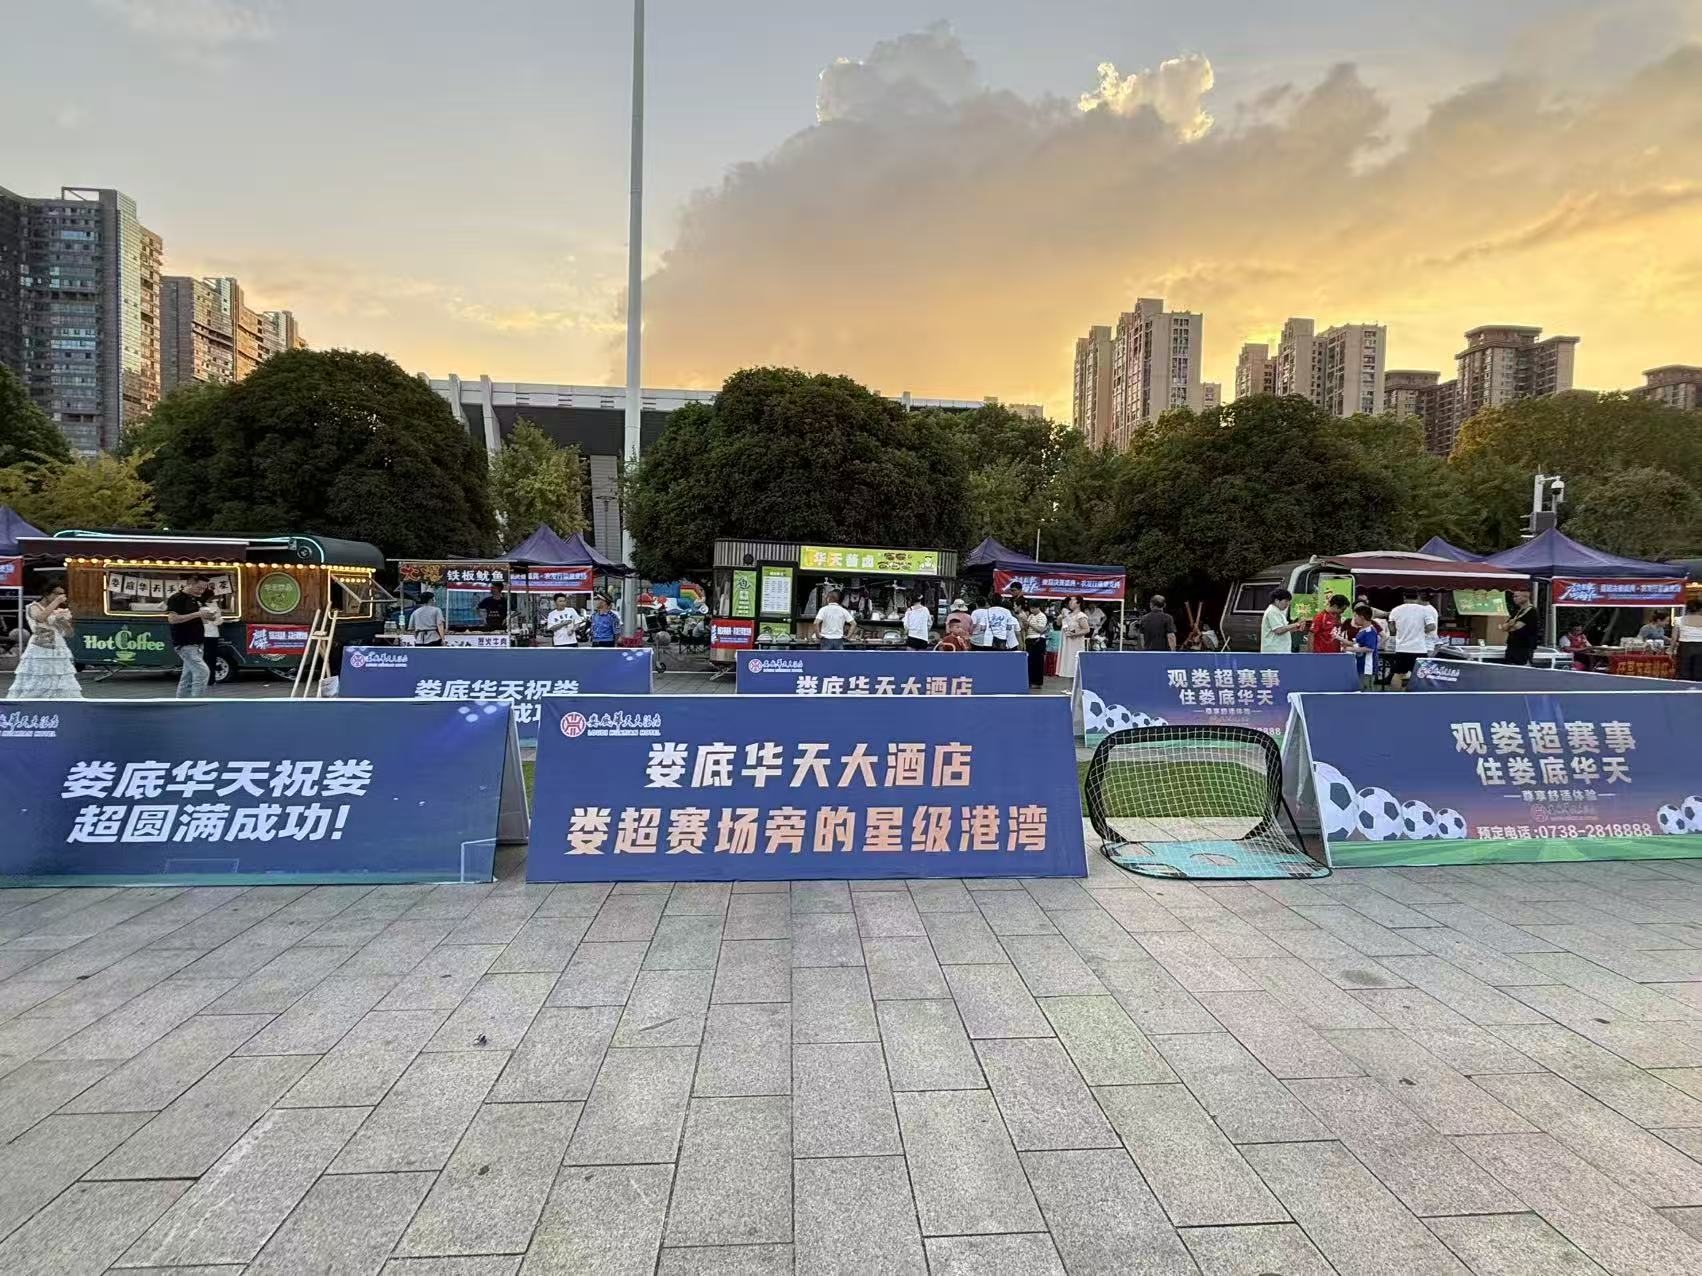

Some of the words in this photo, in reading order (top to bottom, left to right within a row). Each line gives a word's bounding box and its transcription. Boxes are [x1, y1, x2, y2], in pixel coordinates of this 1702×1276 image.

[447, 570, 504, 582] 铁板鱿鱼
[83, 635, 115, 650] Hot
[115, 630, 165, 651] Coffee
[414, 679, 579, 699] 娄底华天祝娄
[796, 676, 974, 695] 娄底华天大酒店
[1167, 668, 1281, 689] 观娄超赛事
[1179, 688, 1273, 706] 住娄底华天
[1450, 721, 1636, 754] 观娄超赛事
[645, 742, 973, 788] 娄底华天大酒店
[1476, 757, 1632, 786] 住娄底华天
[61, 760, 374, 799] 娄底华天祝娄
[1522, 789, 1597, 801] 尊享舒适体验
[564, 805, 1048, 855] 娄超赛场旁的星级港湾
